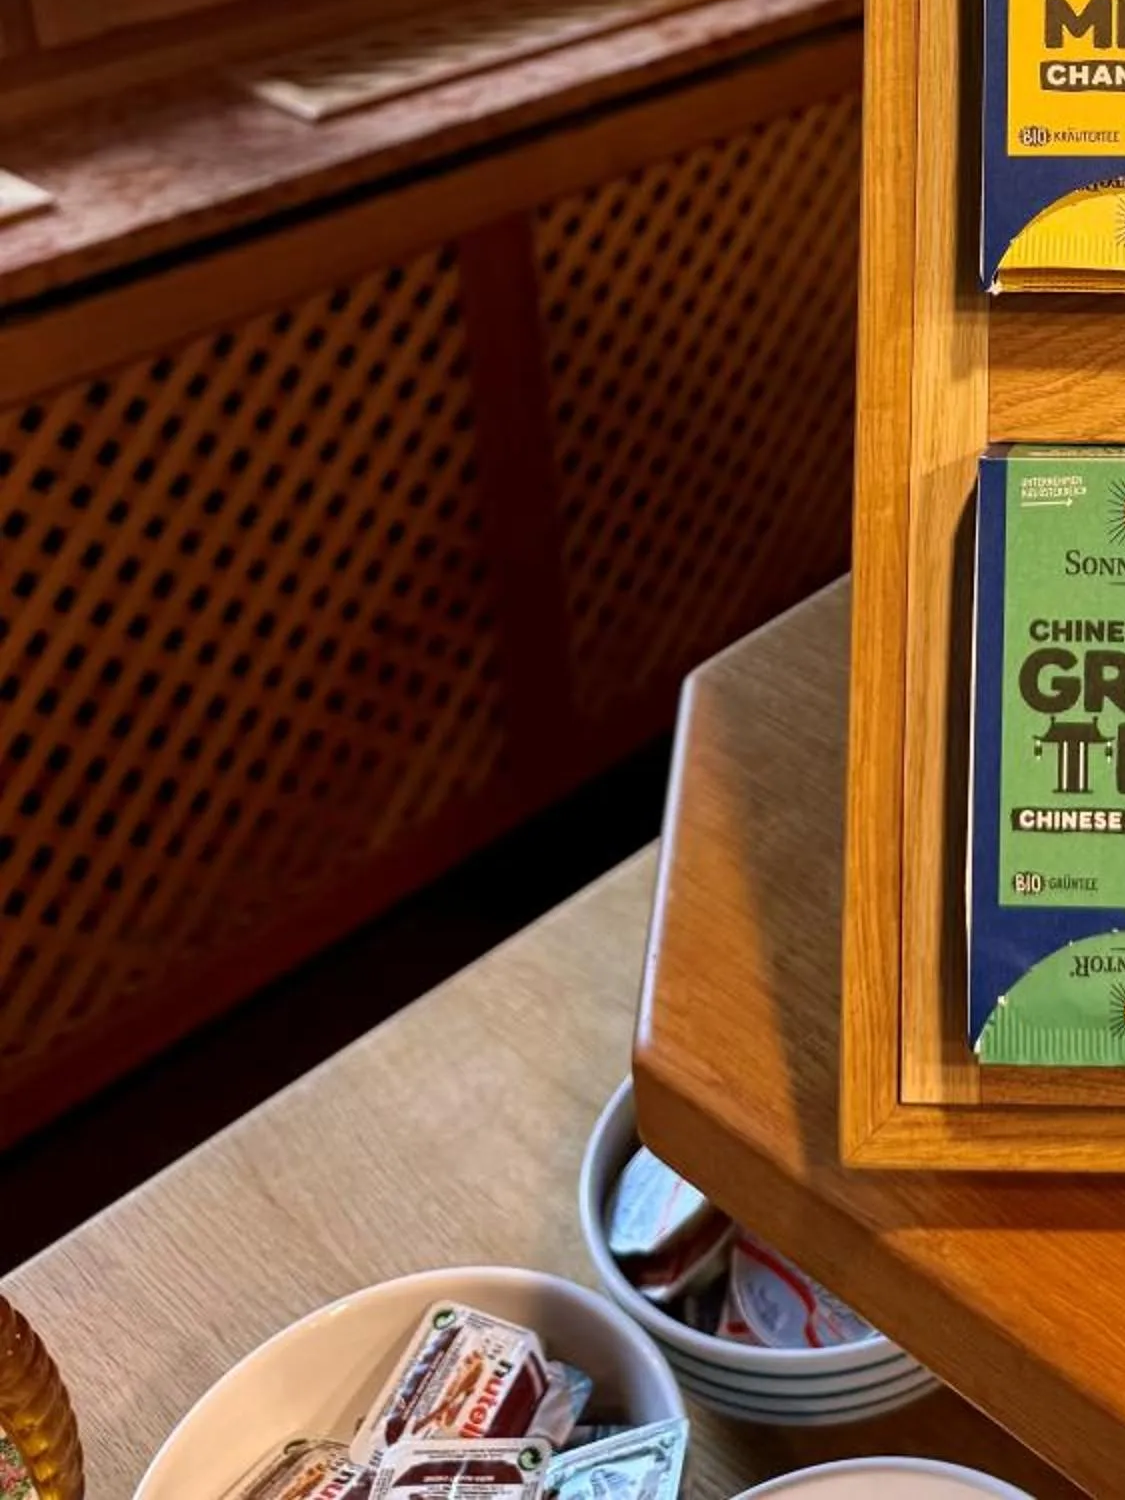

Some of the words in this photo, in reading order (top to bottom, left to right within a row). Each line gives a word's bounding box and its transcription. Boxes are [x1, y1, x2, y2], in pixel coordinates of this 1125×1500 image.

[1021, 126, 1050, 146] BIO
[1019, 809, 1122, 830] CHINESE
[1015, 873, 1042, 894] BIO
[458, 1359, 513, 1438] nutell
